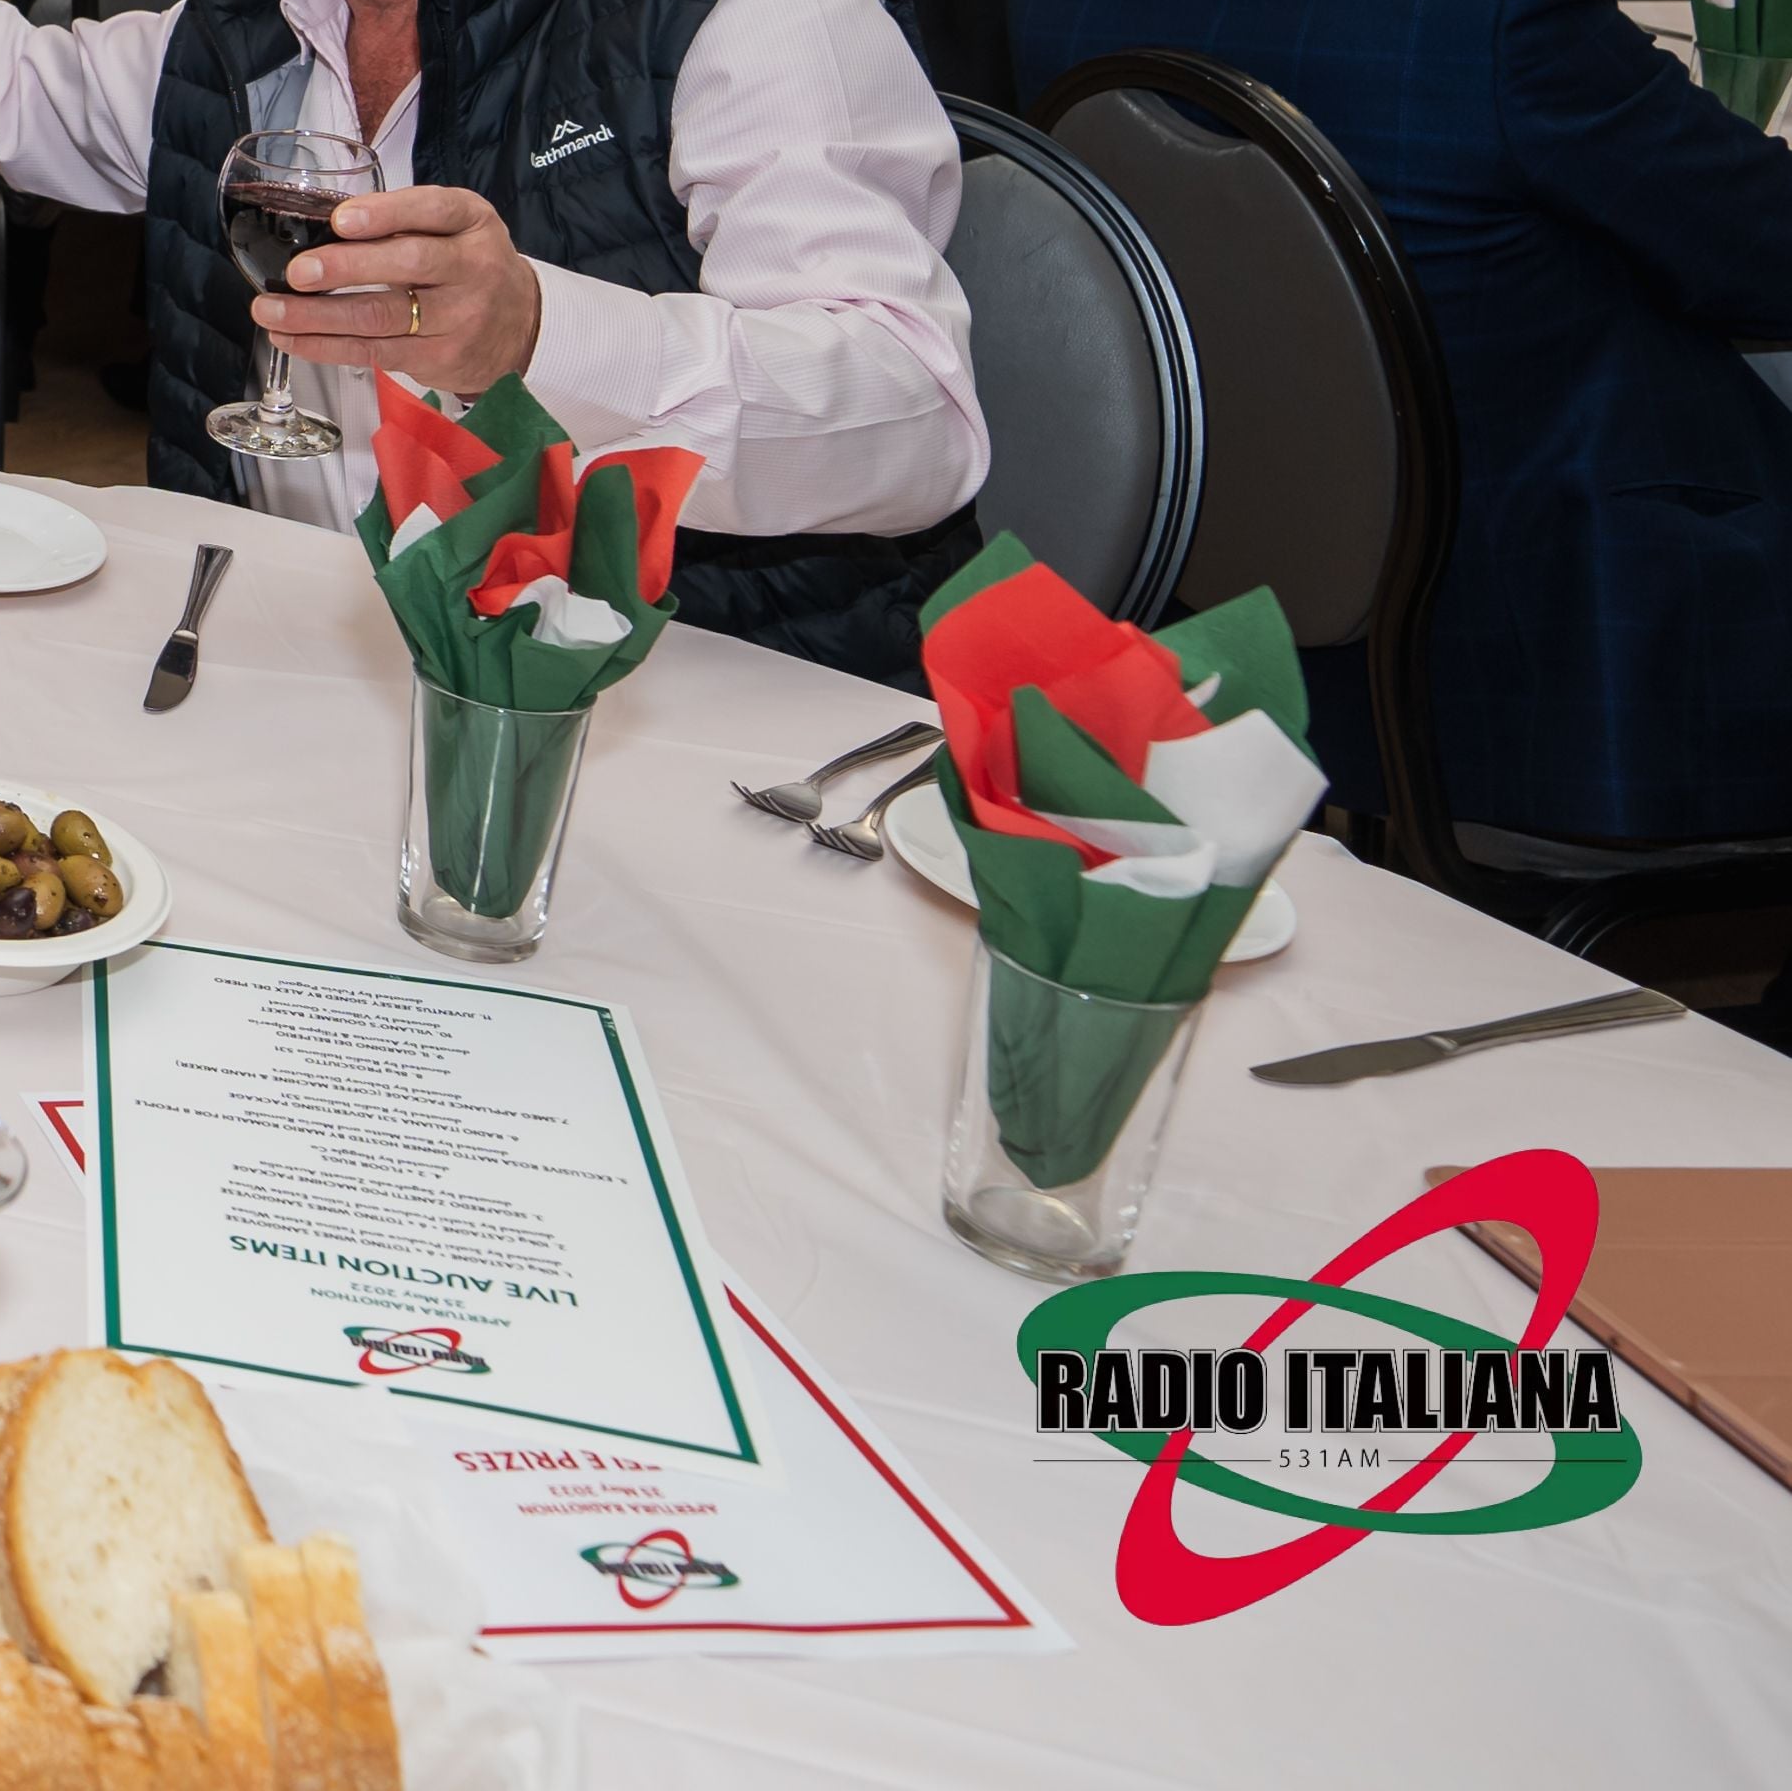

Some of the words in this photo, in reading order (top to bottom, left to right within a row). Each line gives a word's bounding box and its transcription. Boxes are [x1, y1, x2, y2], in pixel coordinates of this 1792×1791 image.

[229, 1234, 325, 1265] ITEMS
[337, 1254, 495, 1294] AUCTION
[310, 1287, 414, 1311] RADIOTHON
[350, 1282, 395, 1295] 2022
[402, 1290, 438, 1303] May
[503, 1280, 577, 1307] LIVE
[443, 1298, 464, 1307] 25
[419, 1305, 511, 1327] APERTURA
[455, 1449, 580, 1472] PRIZES
[518, 1502, 626, 1516] RADIOTHON
[631, 1503, 718, 1516] APERTURA
